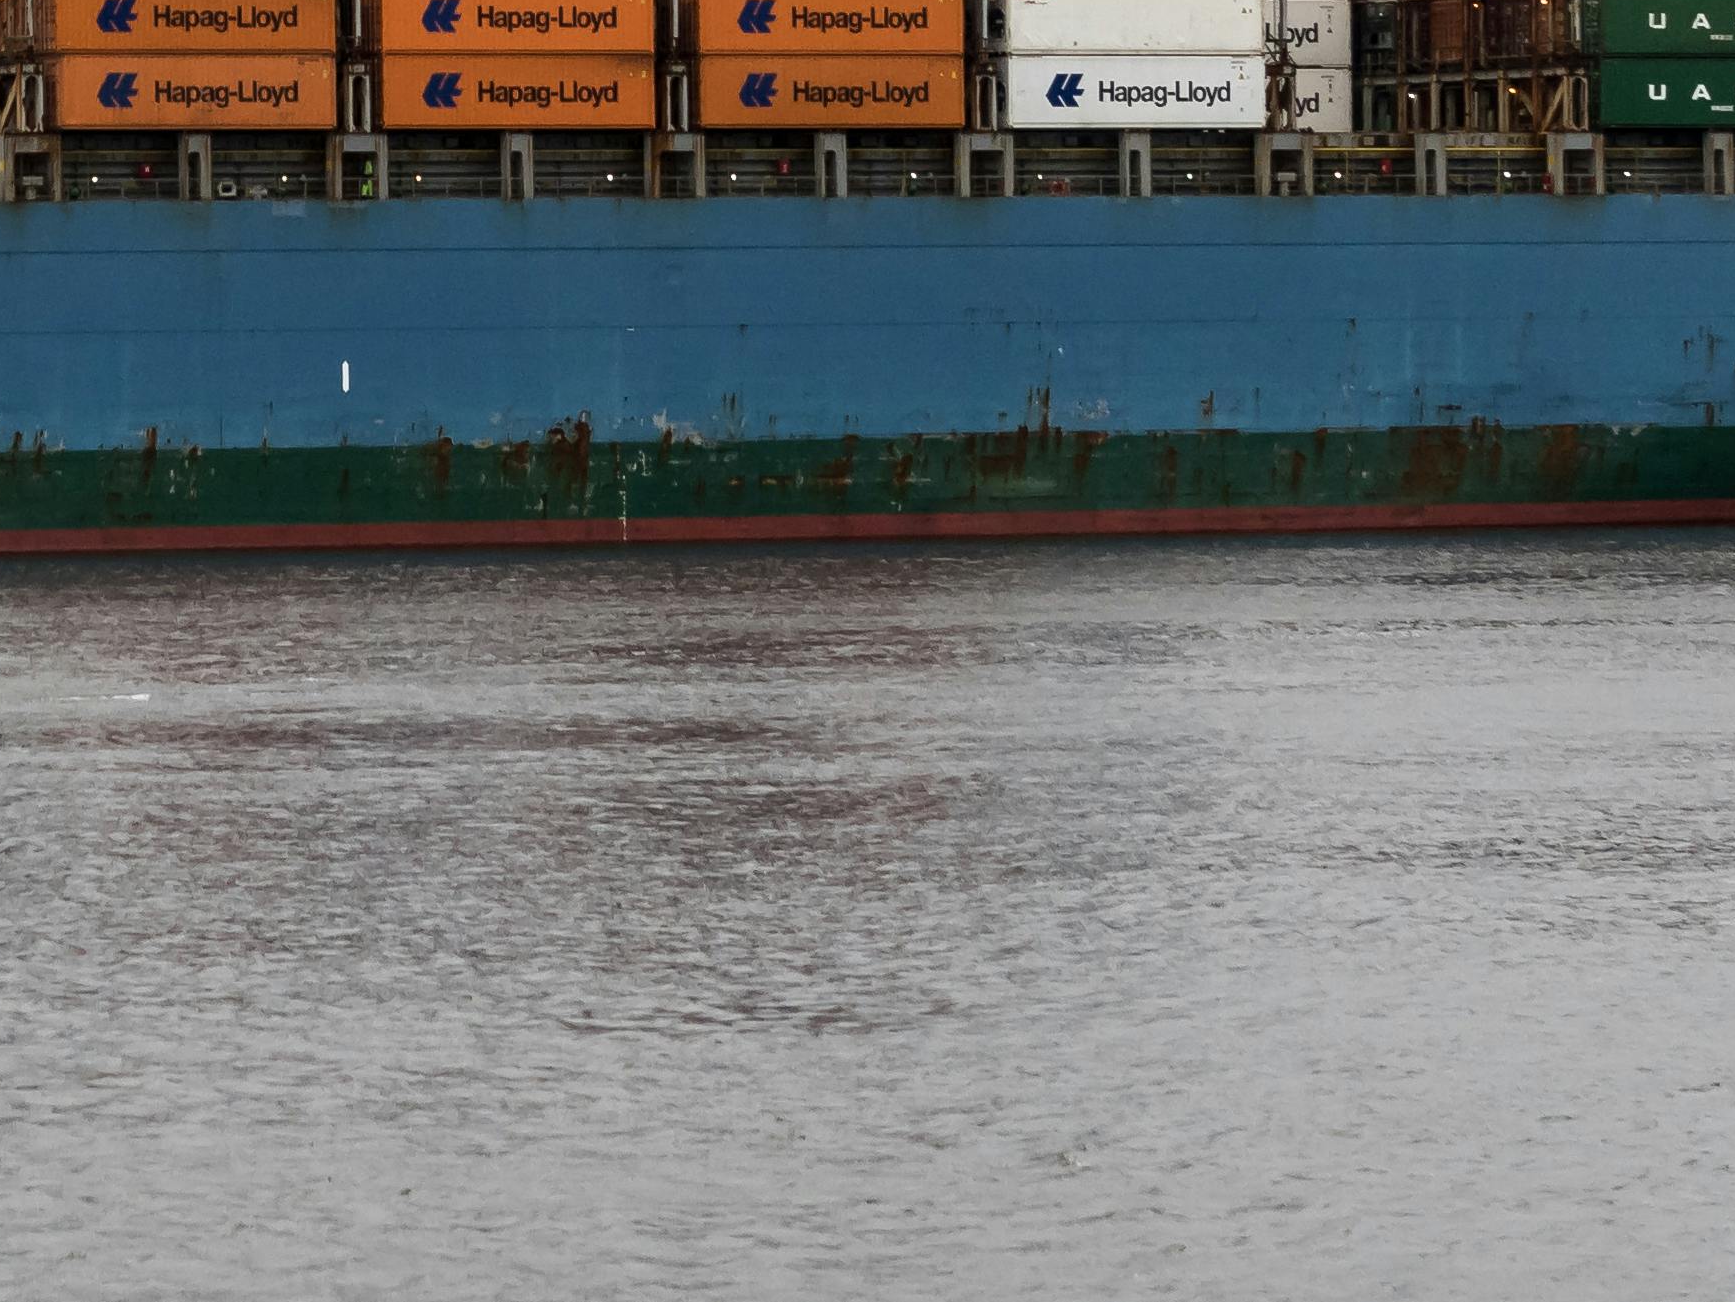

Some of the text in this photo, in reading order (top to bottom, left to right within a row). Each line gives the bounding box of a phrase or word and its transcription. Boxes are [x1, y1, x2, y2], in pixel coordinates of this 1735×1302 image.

[153, 5, 298, 34] Hapag-Lloyd
[477, 6, 617, 33] Hapag-Lloyd
[791, 6, 928, 33] Hapag-Lloyd
[155, 80, 299, 108] Hapag-Lloyd
[478, 81, 618, 108] Hapag-Lloyd
[793, 81, 929, 108] Hapag-Lloyd
[1098, 80, 1230, 106] Hapag-Lloyd
